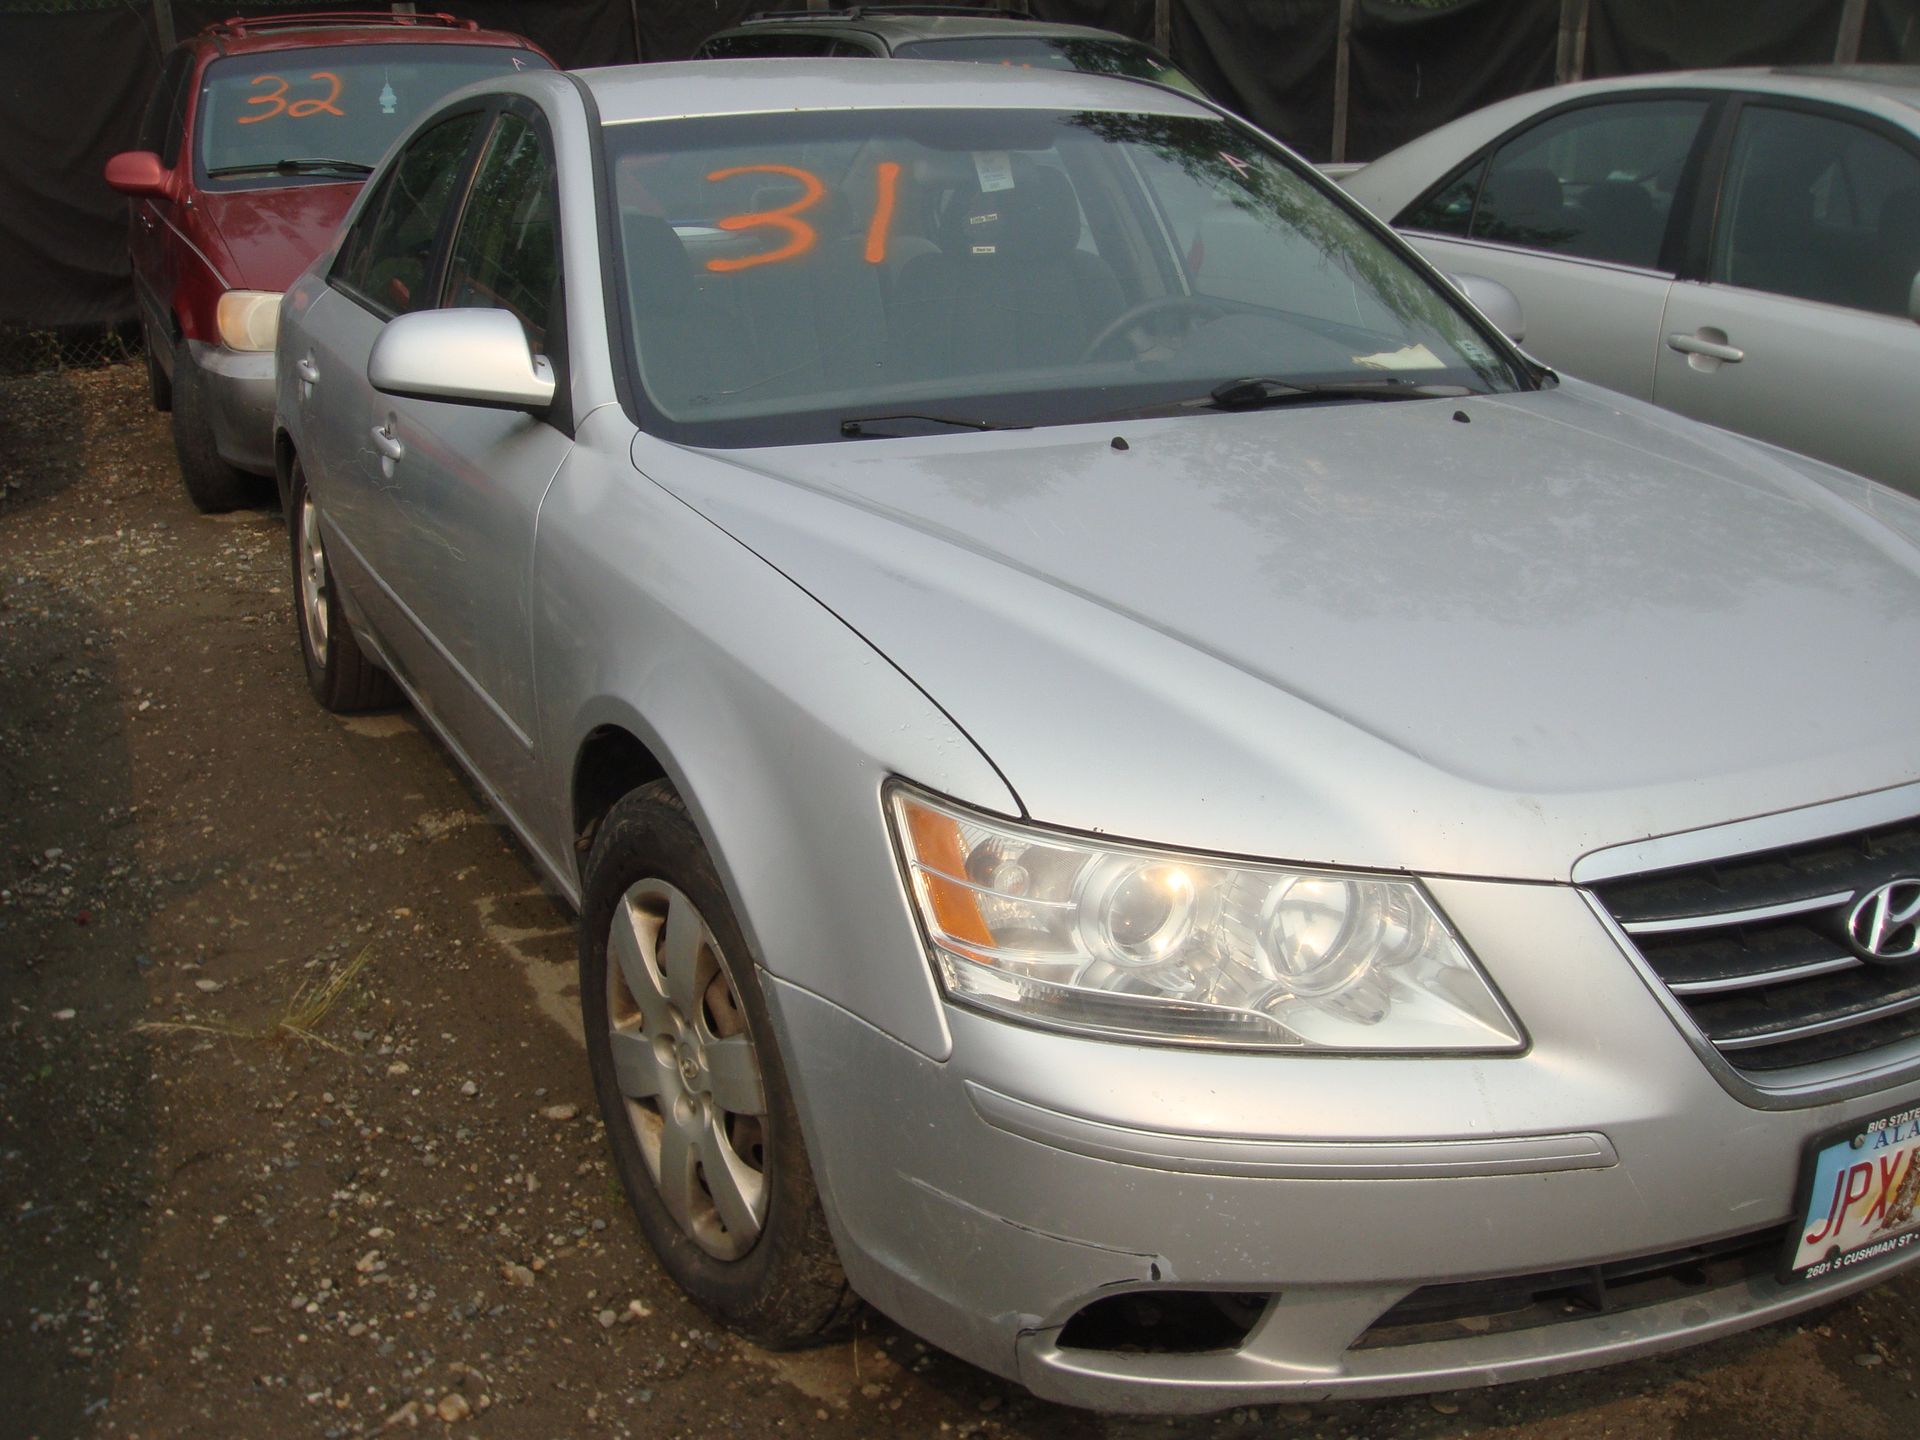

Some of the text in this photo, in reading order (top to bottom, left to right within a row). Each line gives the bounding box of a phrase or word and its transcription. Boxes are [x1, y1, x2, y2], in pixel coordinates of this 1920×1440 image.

[237, 72, 344, 124] 32
[706, 162, 900, 273] 31
[1867, 1118, 1887, 1133] BIG
[1806, 1149, 1904, 1244] JPX
[1805, 1233, 1913, 1279] 2601 S CUSHMAN ST
